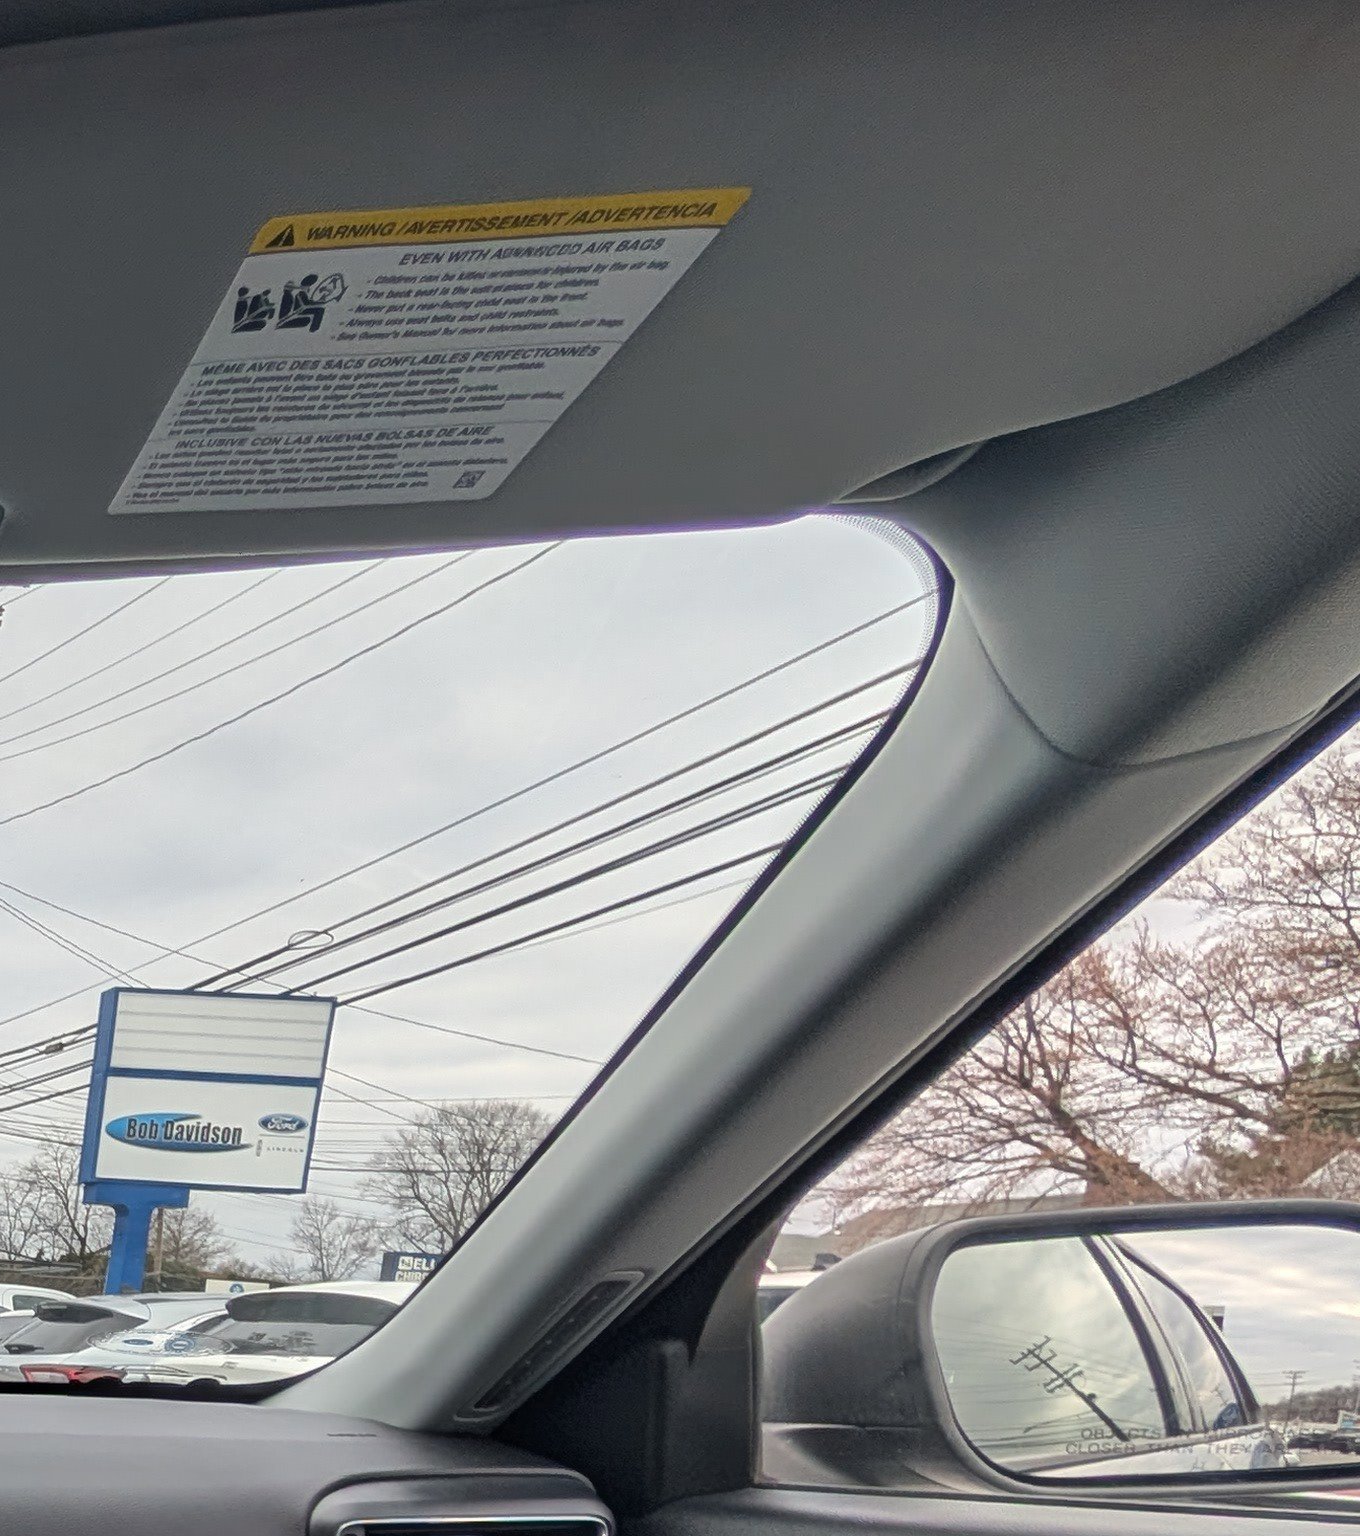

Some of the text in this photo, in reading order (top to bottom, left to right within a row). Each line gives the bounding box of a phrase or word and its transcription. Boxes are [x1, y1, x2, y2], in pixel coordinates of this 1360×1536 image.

[307, 221, 398, 240] WARNING
[399, 252, 445, 266] EVEN
[448, 249, 490, 262] WITH
[582, 240, 615, 254] AIR
[615, 238, 666, 252] BAGS
[246, 360, 288, 371] AVEC
[289, 360, 320, 370] DES
[250, 437, 283, 447] CON
[126, 1118, 243, 1145] Bob Davidson
[264, 1116, 301, 1132] Ford
